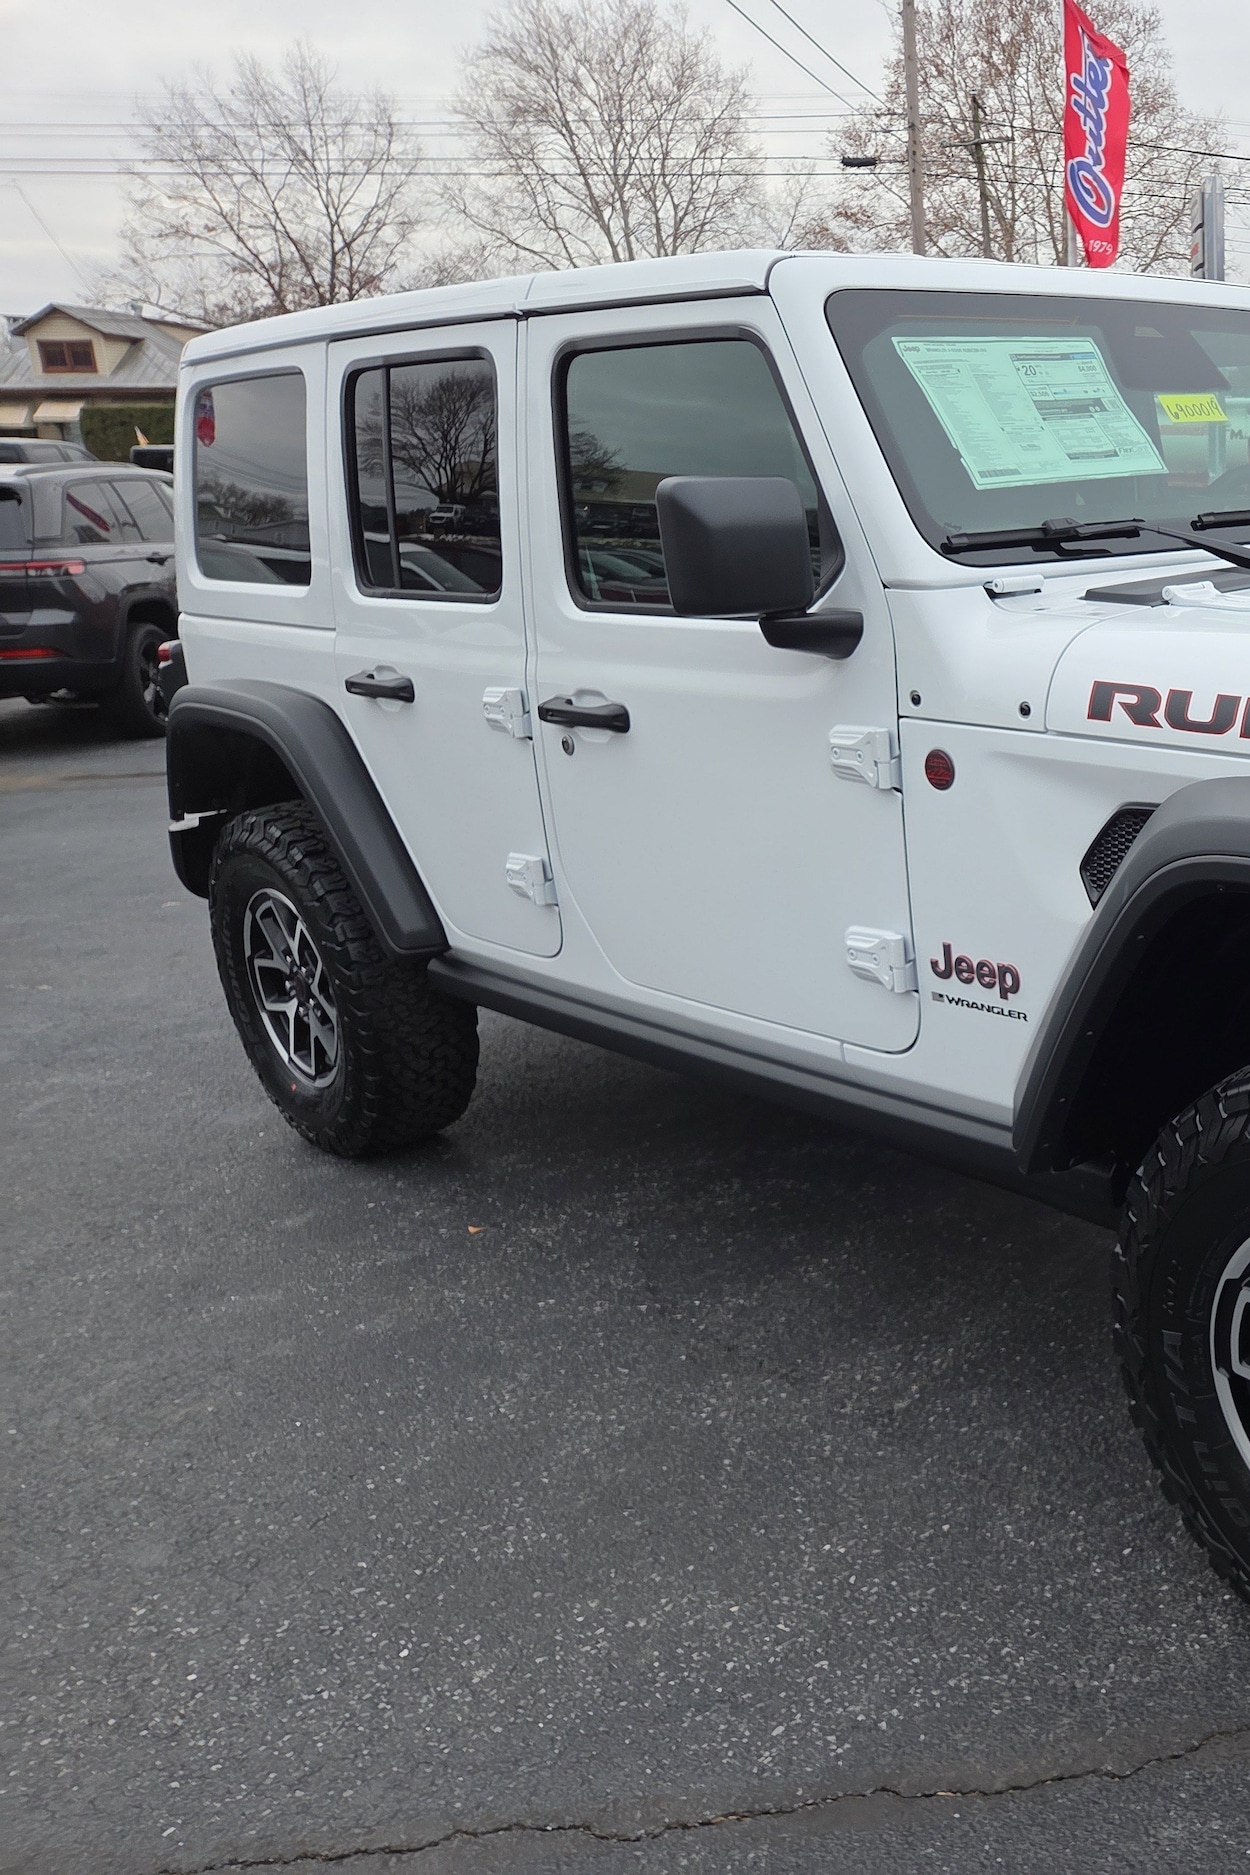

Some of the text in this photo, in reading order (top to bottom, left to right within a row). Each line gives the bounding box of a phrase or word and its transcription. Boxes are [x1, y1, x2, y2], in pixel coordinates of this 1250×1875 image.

[1088, 239, 1113, 255] 1979
[930, 941, 1021, 1001] Jeep
[945, 994, 1029, 1022] WRANGLER
